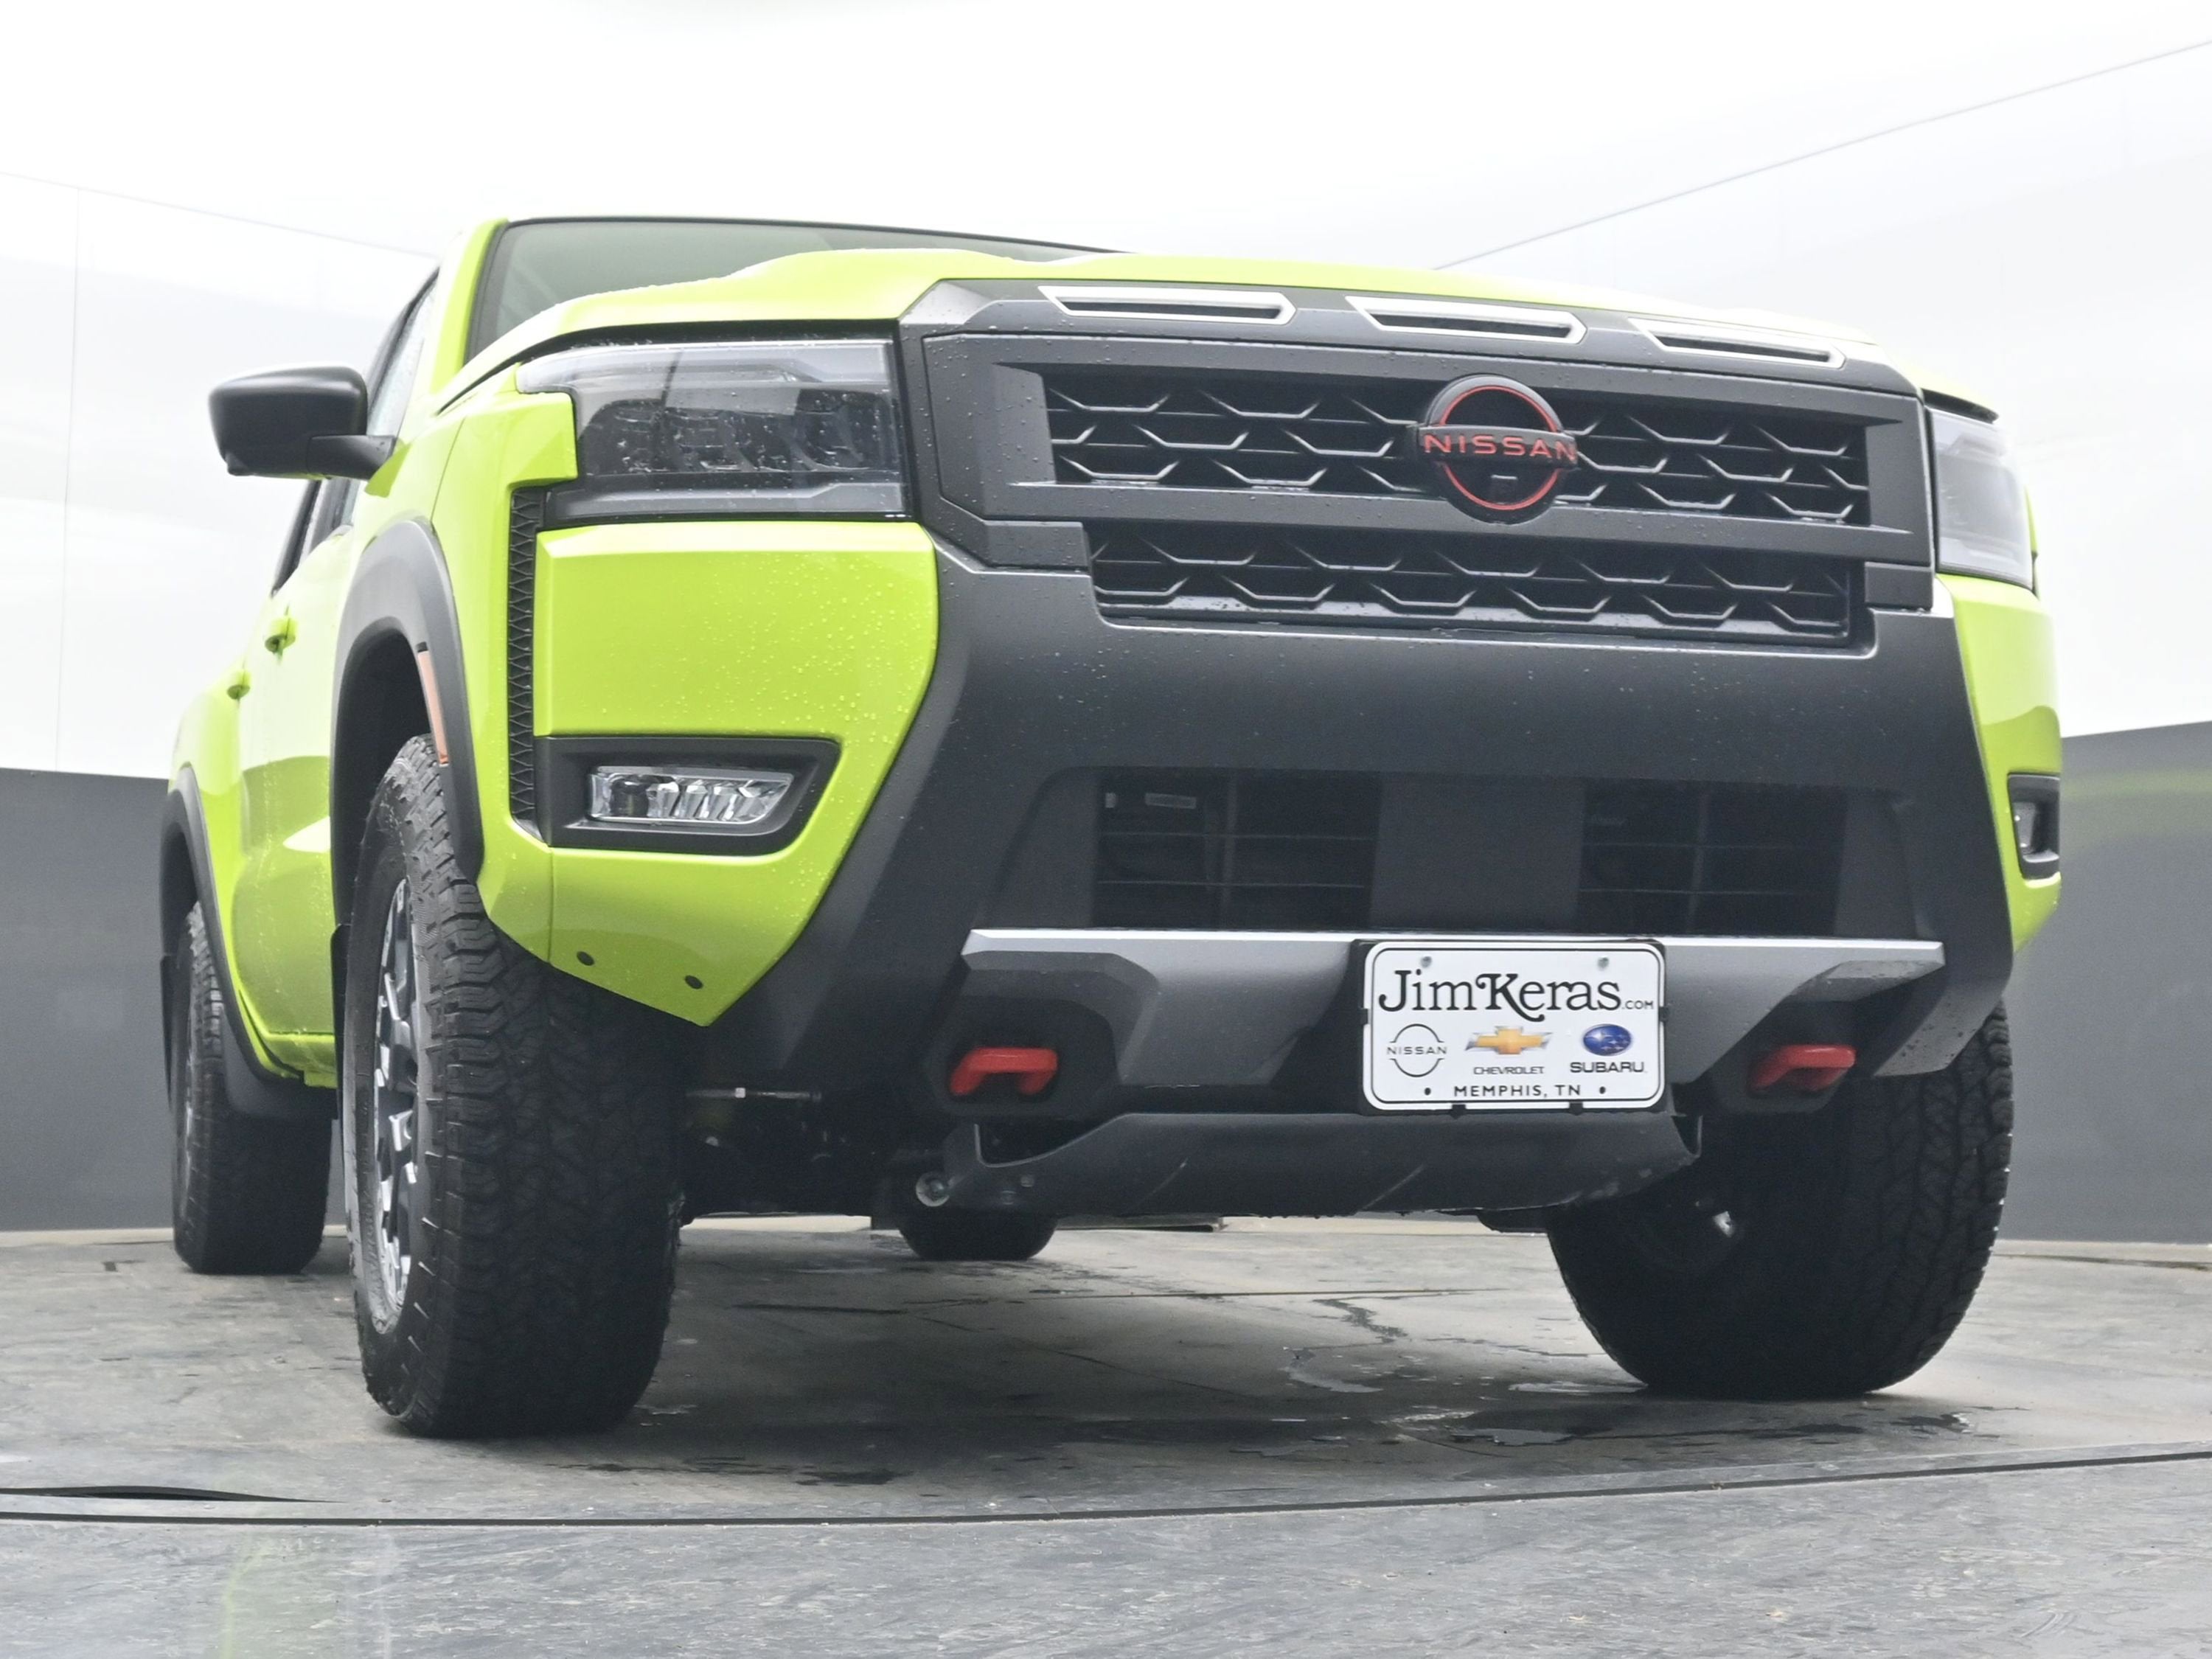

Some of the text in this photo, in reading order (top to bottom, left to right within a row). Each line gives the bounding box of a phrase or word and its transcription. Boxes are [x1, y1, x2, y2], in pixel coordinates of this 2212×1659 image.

[1423, 434, 1576, 461] NISSAN
[1386, 1046, 1447, 1055] NISSAN
[1473, 1065, 1545, 1075] CHEVROLET
[1570, 1061, 1645, 1074] SUBARU
[1454, 1084, 1581, 1098] MEMPHIS, TN
